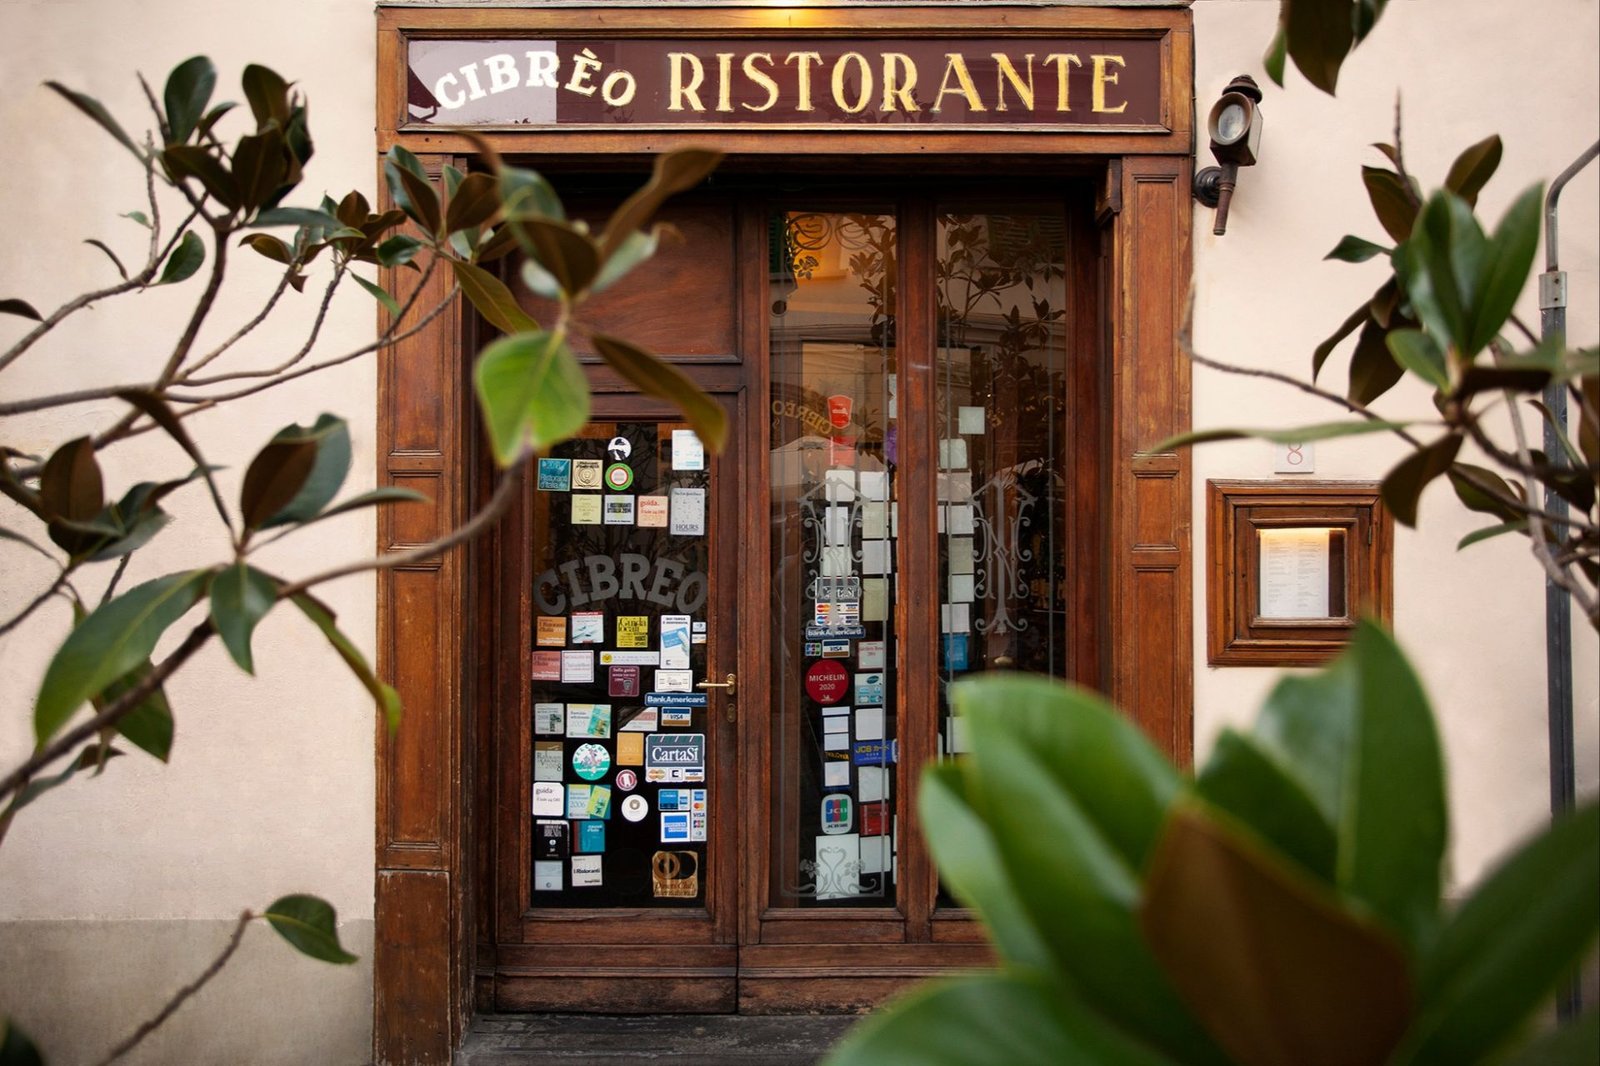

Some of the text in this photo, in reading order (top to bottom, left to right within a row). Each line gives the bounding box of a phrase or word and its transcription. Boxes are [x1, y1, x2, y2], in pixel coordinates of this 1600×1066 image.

[434, 47, 1128, 114] CIBRÈO RISTORANTE
[1287, 441, 1303, 465] 8
[809, 674, 845, 682] MICHELIN
